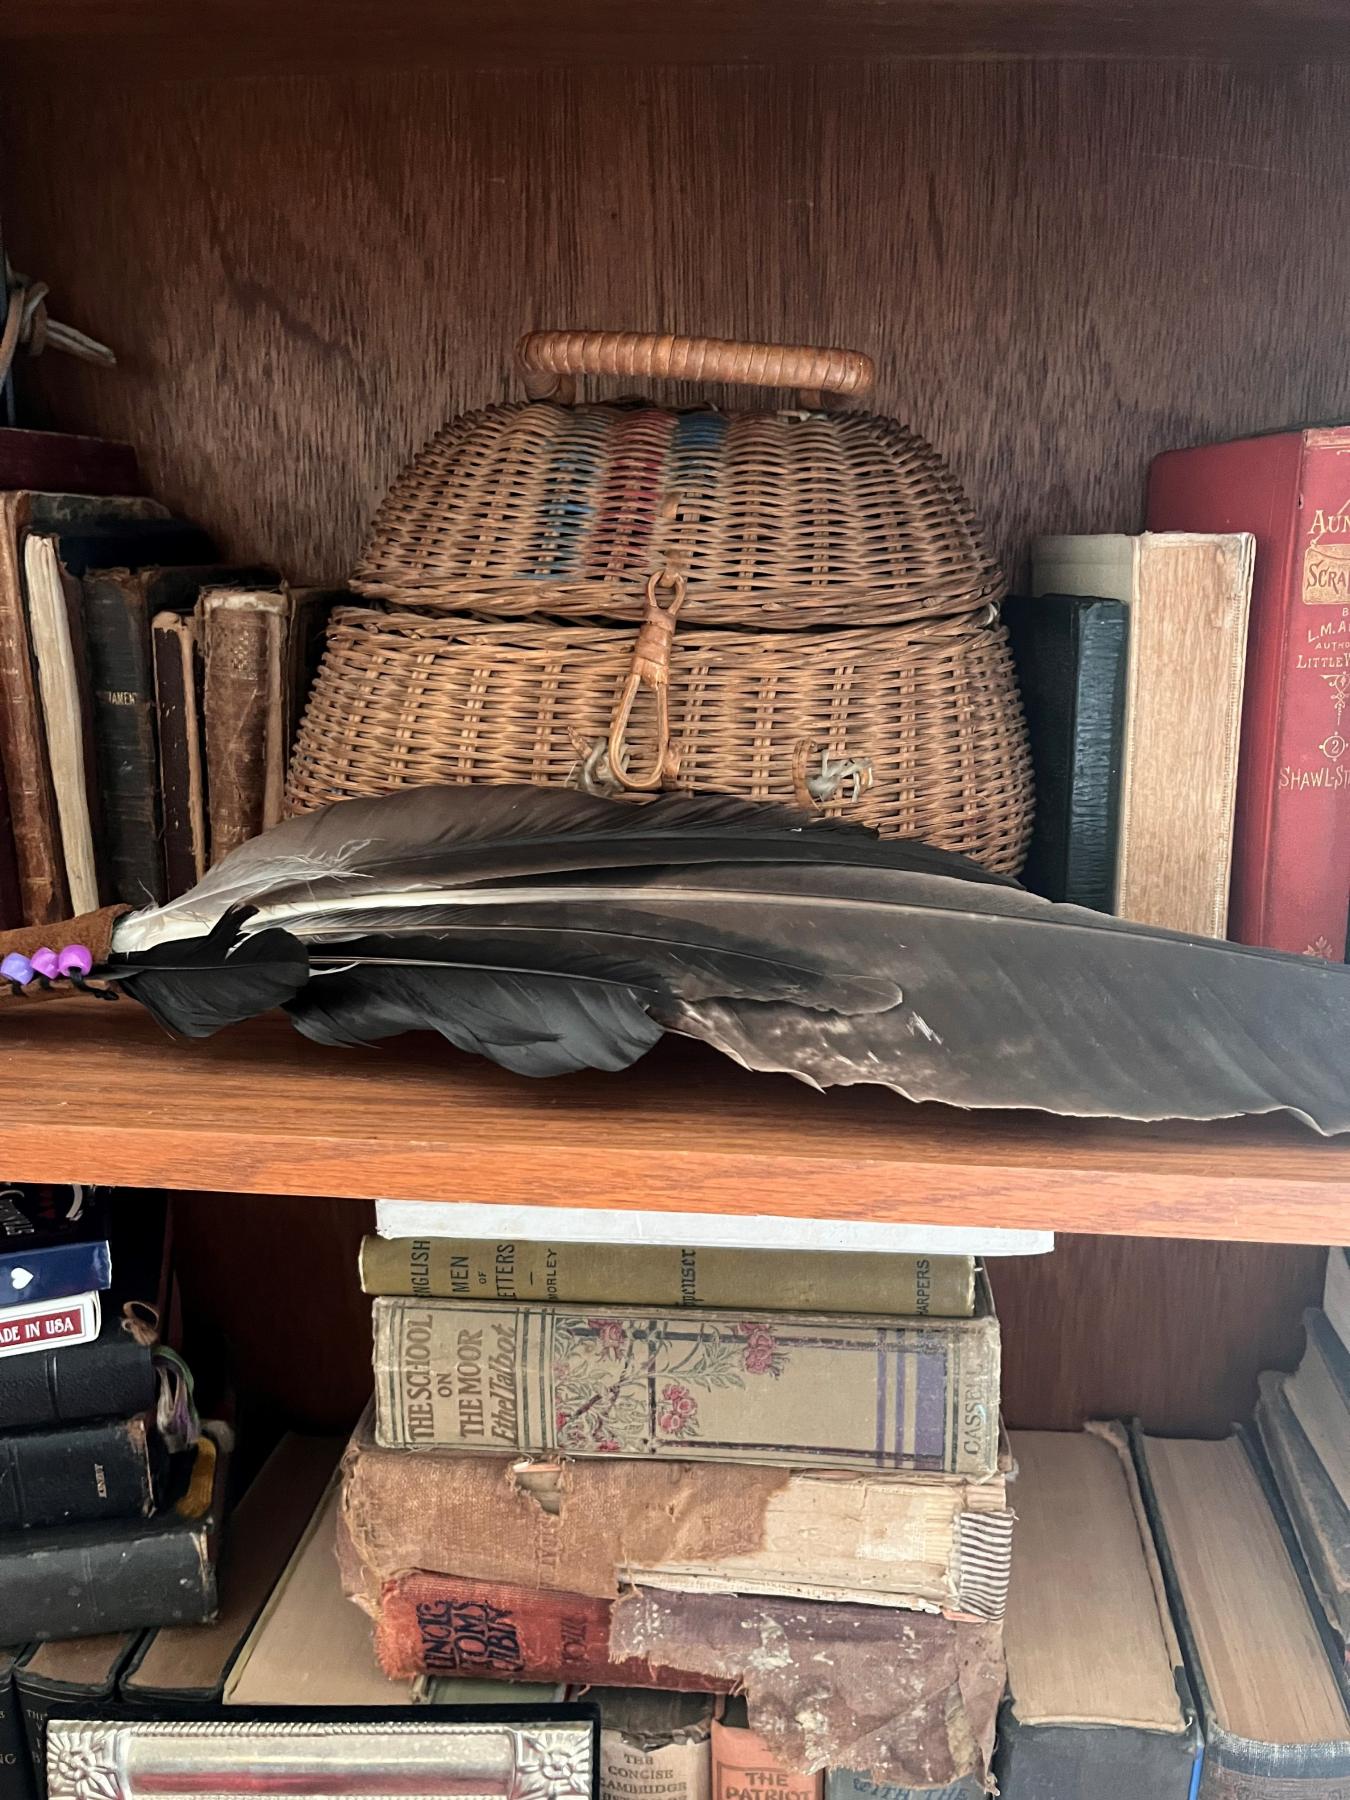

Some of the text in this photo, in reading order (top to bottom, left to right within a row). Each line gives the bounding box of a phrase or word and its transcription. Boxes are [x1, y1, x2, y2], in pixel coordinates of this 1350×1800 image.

[1306, 560, 1350, 594] SCRA
[1279, 765, 1350, 790] SHAWL-ST
[450, 1256, 470, 1292] MEN
[478, 1271, 487, 1285] OF
[496, 1244, 517, 1299] ETTERS
[25, 1320, 40, 1338] IN
[45, 1316, 74, 1334] USA
[405, 1314, 435, 1440] THE SCHOOL
[437, 1372, 452, 1398] ON
[457, 1329, 484, 1439] THE MOOR
[489, 1323, 517, 1444] Ethel Talbot
[624, 1753, 654, 1766] THE
[607, 1766, 674, 1780] CONCISE
[745, 1772, 789, 1788] THE
[725, 1786, 813, 1800] PATRIOT
